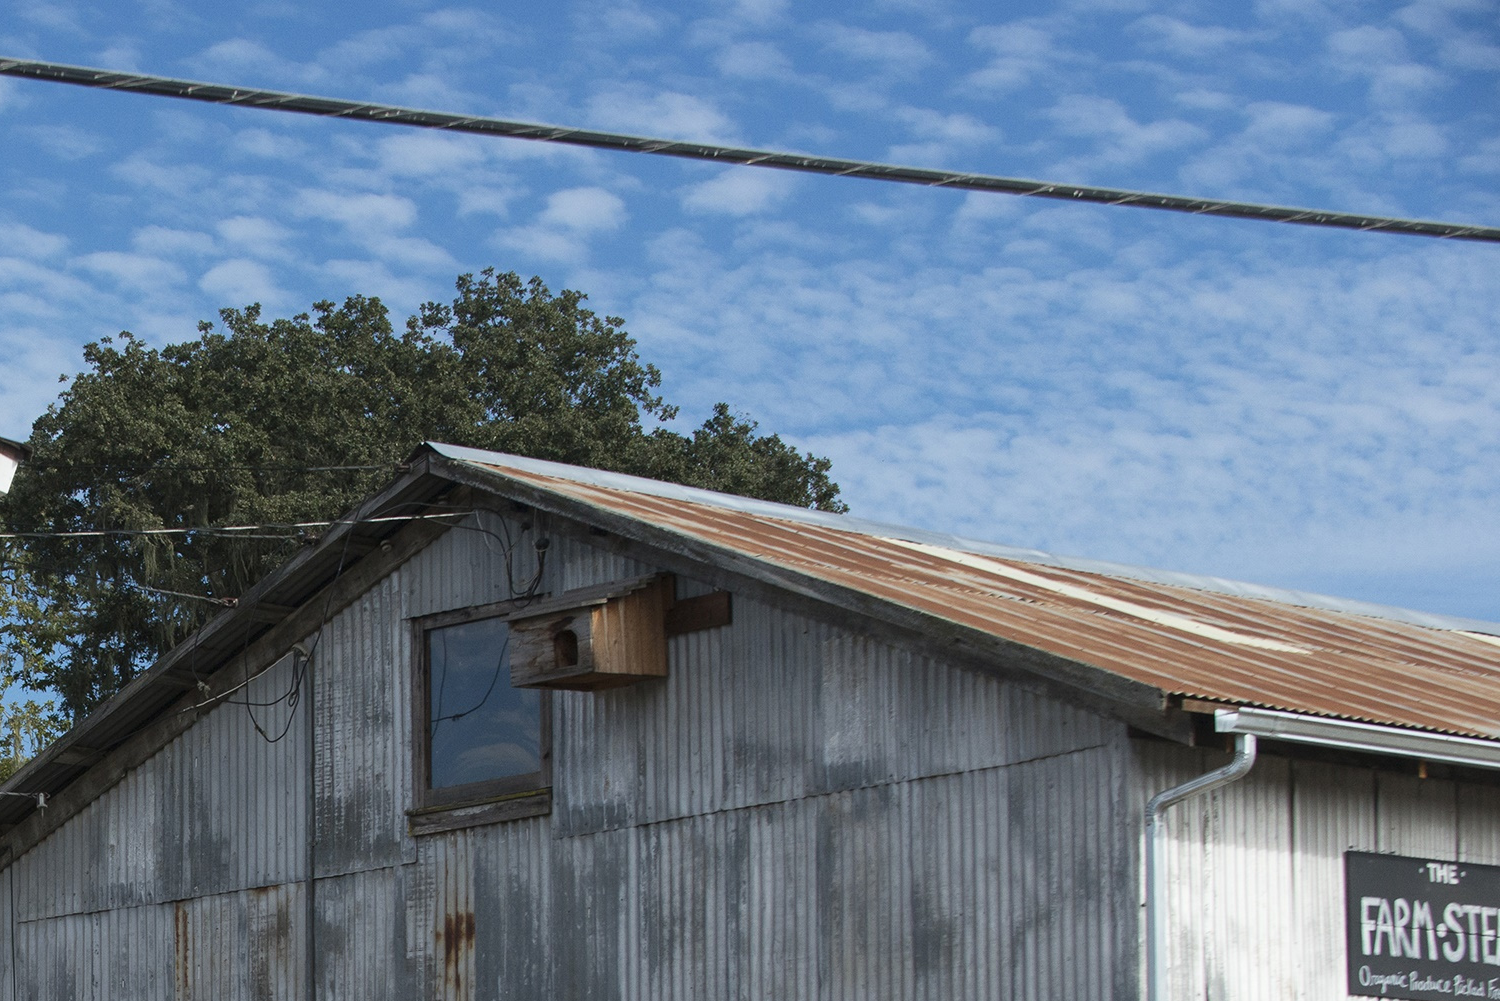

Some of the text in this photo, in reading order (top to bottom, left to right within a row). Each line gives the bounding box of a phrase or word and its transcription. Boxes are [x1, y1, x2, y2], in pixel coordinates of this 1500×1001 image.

[1426, 863, 1460, 884] THE
[1359, 965, 1408, 994] Organic
[1409, 971, 1452, 994] Produce
[1453, 974, 1486, 997] Picked
